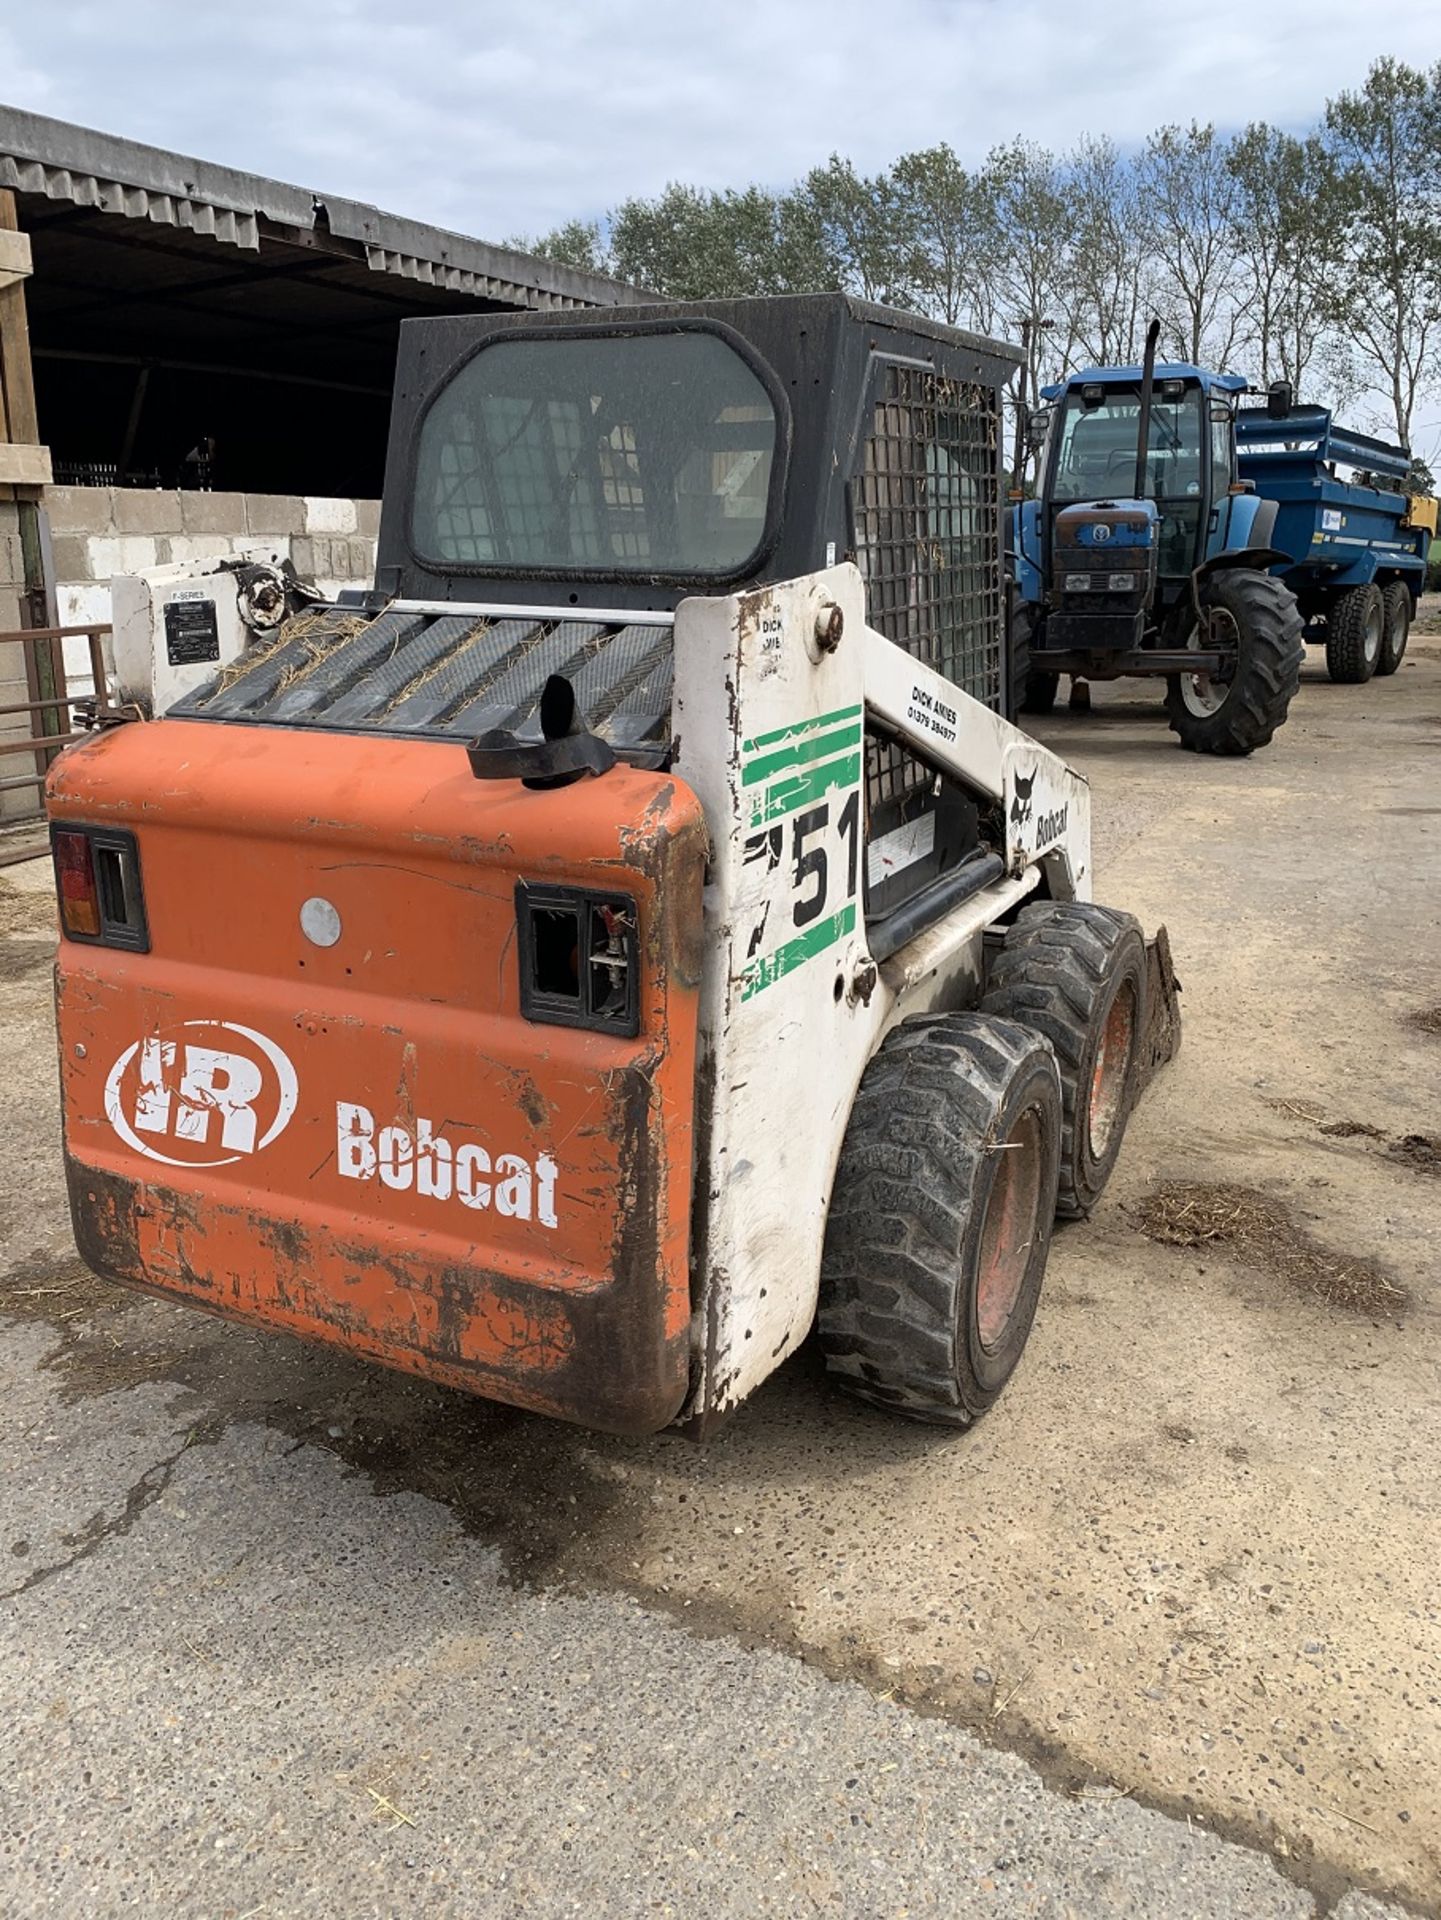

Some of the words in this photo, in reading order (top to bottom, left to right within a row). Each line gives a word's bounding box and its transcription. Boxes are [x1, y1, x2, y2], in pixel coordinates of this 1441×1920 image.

[907, 706, 930, 727] 01379
[912, 686, 932, 710] DICK
[1036, 800, 1069, 851] Bobcat
[742, 790, 860, 958] 751
[336, 1101, 559, 1229] Bobcat
